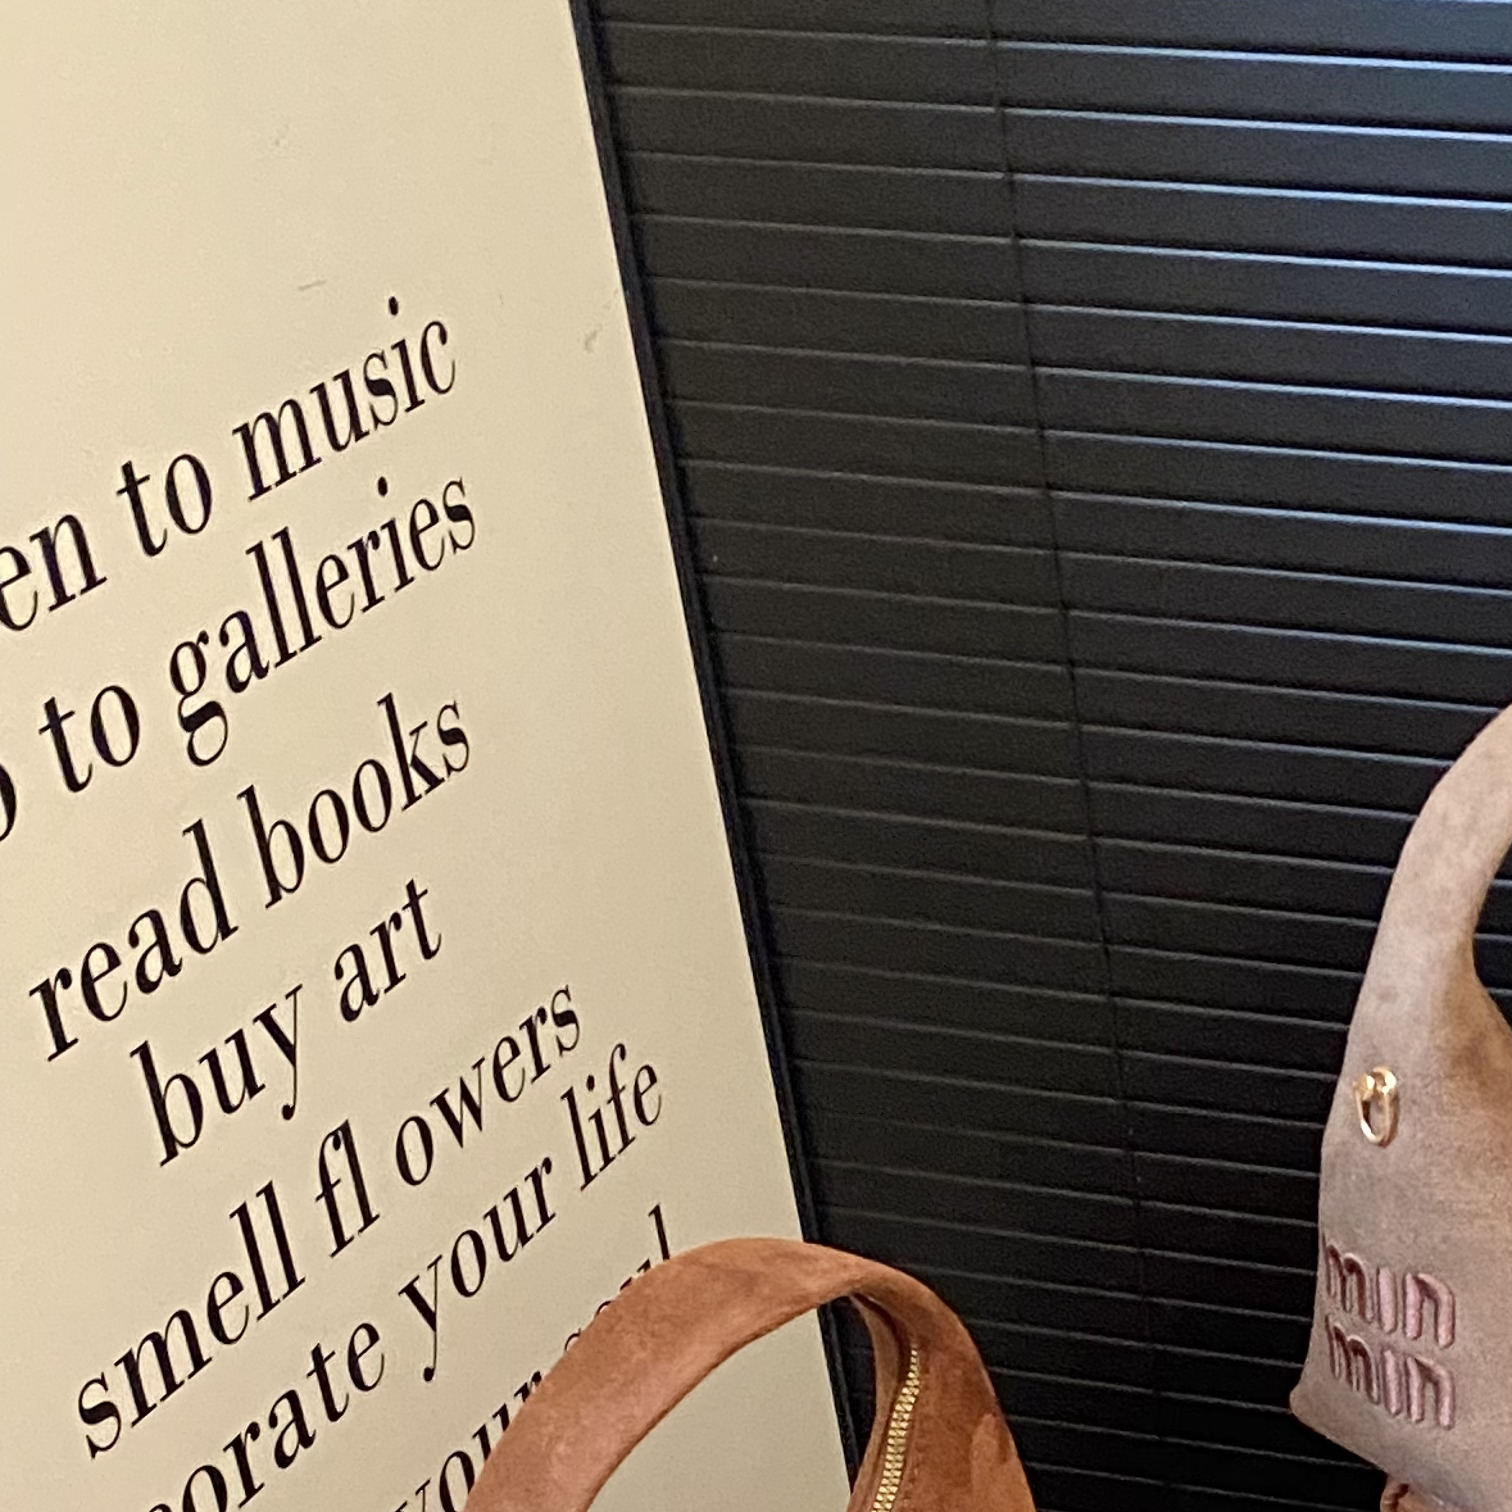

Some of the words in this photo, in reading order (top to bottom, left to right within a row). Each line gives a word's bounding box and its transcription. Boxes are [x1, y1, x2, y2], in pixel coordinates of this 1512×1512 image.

[117, 454, 212, 557] to
[231, 297, 456, 501] music
[38, 686, 140, 793] to
[170, 477, 475, 767] galleries
[29, 819, 239, 1062] read
[237, 693, 470, 909] books
[130, 984, 303, 1167] buy
[335, 879, 442, 1023] art
[78, 1181, 306, 1459] smell
[397, 1157, 556, 1383] your
[561, 1044, 662, 1192] life
